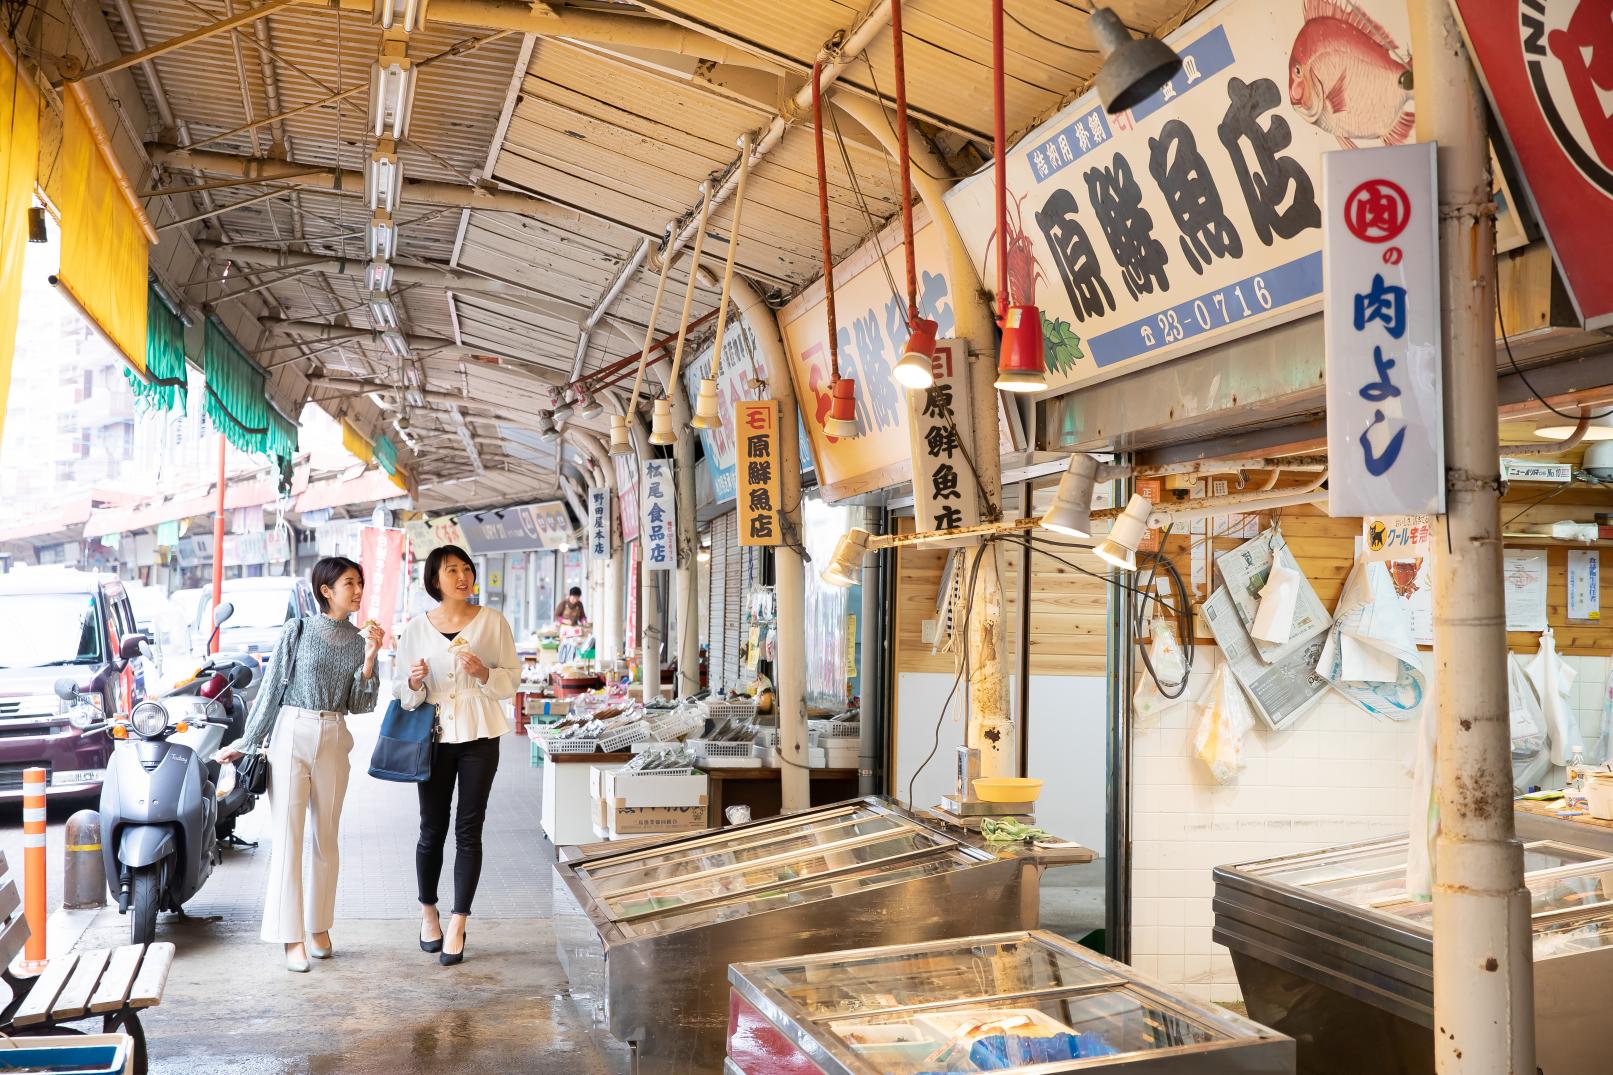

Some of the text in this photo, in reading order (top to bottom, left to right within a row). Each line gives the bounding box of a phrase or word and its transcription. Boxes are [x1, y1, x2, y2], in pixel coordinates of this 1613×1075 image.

[1035, 76, 1322, 324] 原鮮魚店
[593, 492, 605, 555] 野田屋本店
[646, 462, 667, 564] 松尾食品店
[1387, 525, 1433, 548] クール宅急
